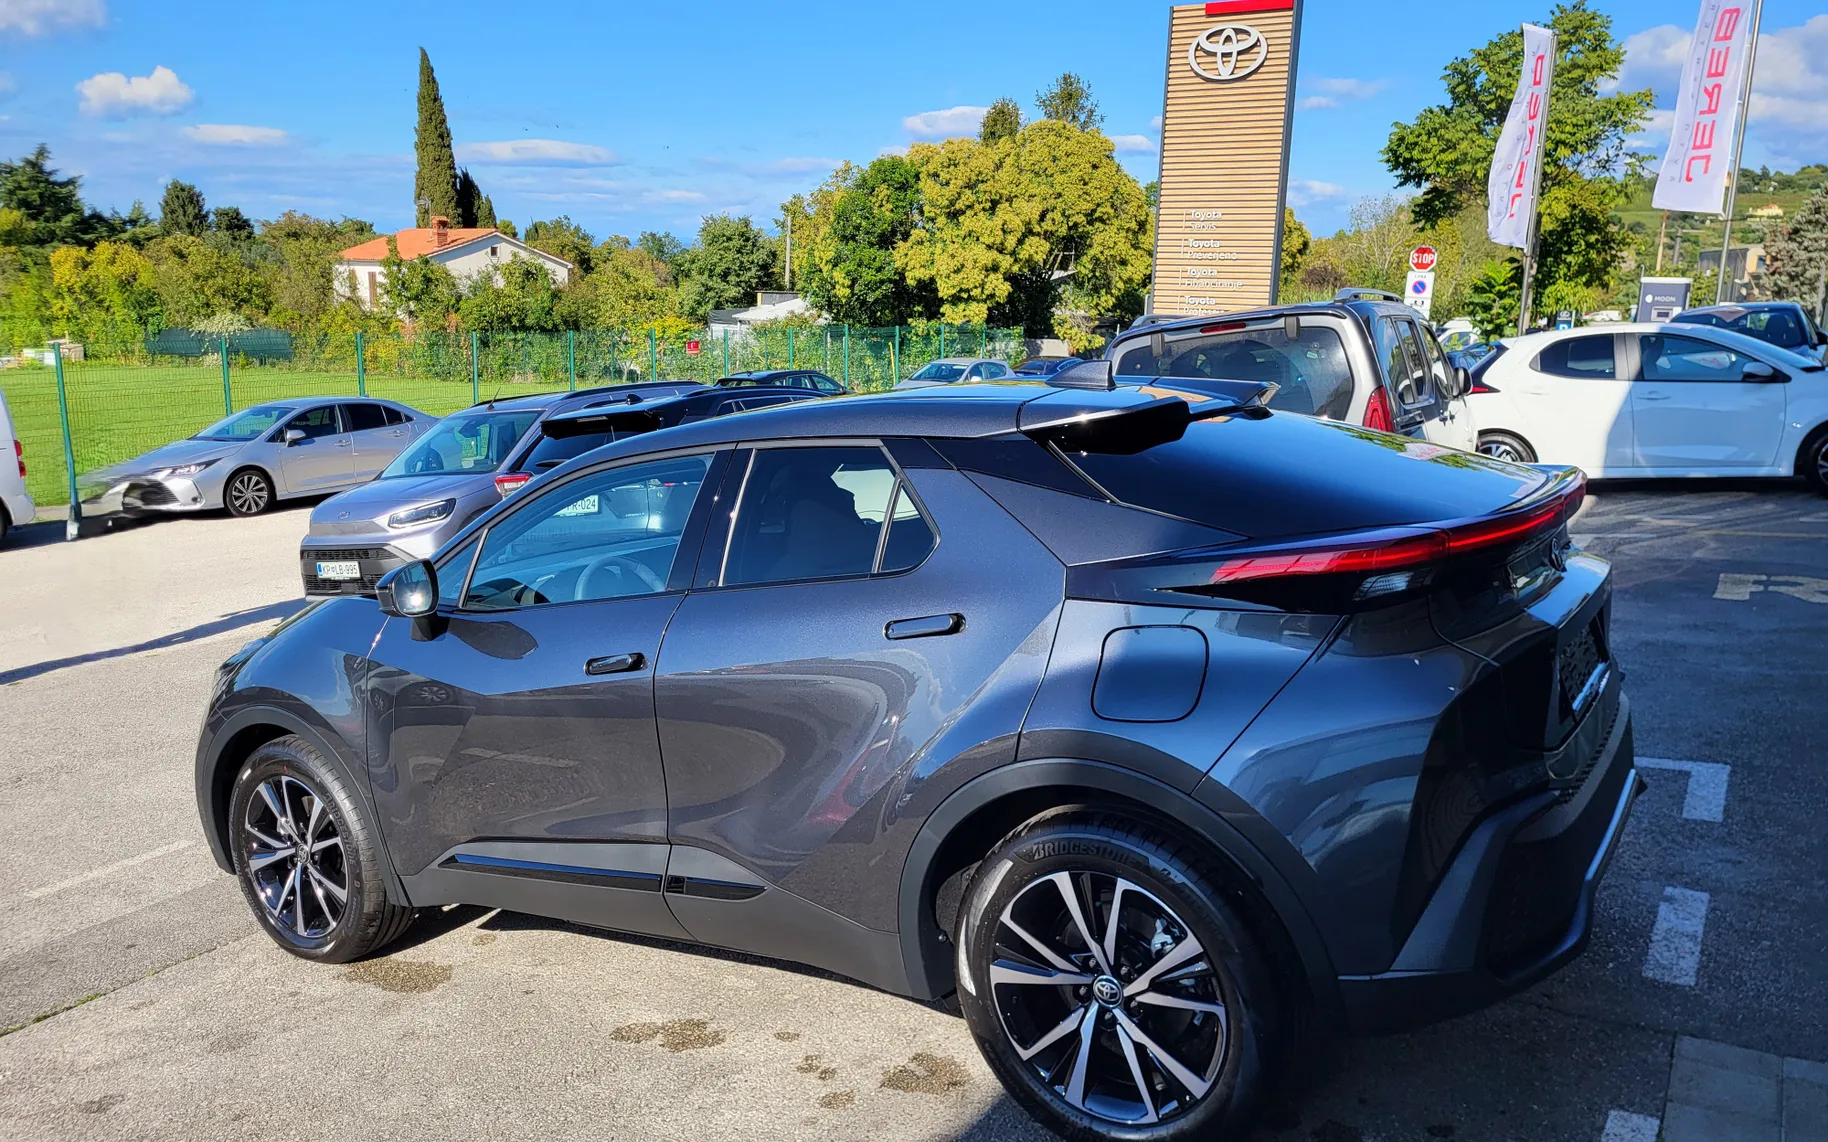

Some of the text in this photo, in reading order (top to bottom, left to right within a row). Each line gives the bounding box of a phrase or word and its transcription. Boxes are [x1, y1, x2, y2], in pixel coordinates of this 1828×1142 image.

[1191, 210, 1222, 222] Toyota
[1189, 223, 1217, 231] Servis
[1188, 239, 1220, 250] Toyota
[1412, 253, 1434, 264] STOP
[1186, 267, 1218, 279] Toyota
[1184, 295, 1216, 307] Toyota
[1032, 840, 1142, 868] BRIDGESTON
